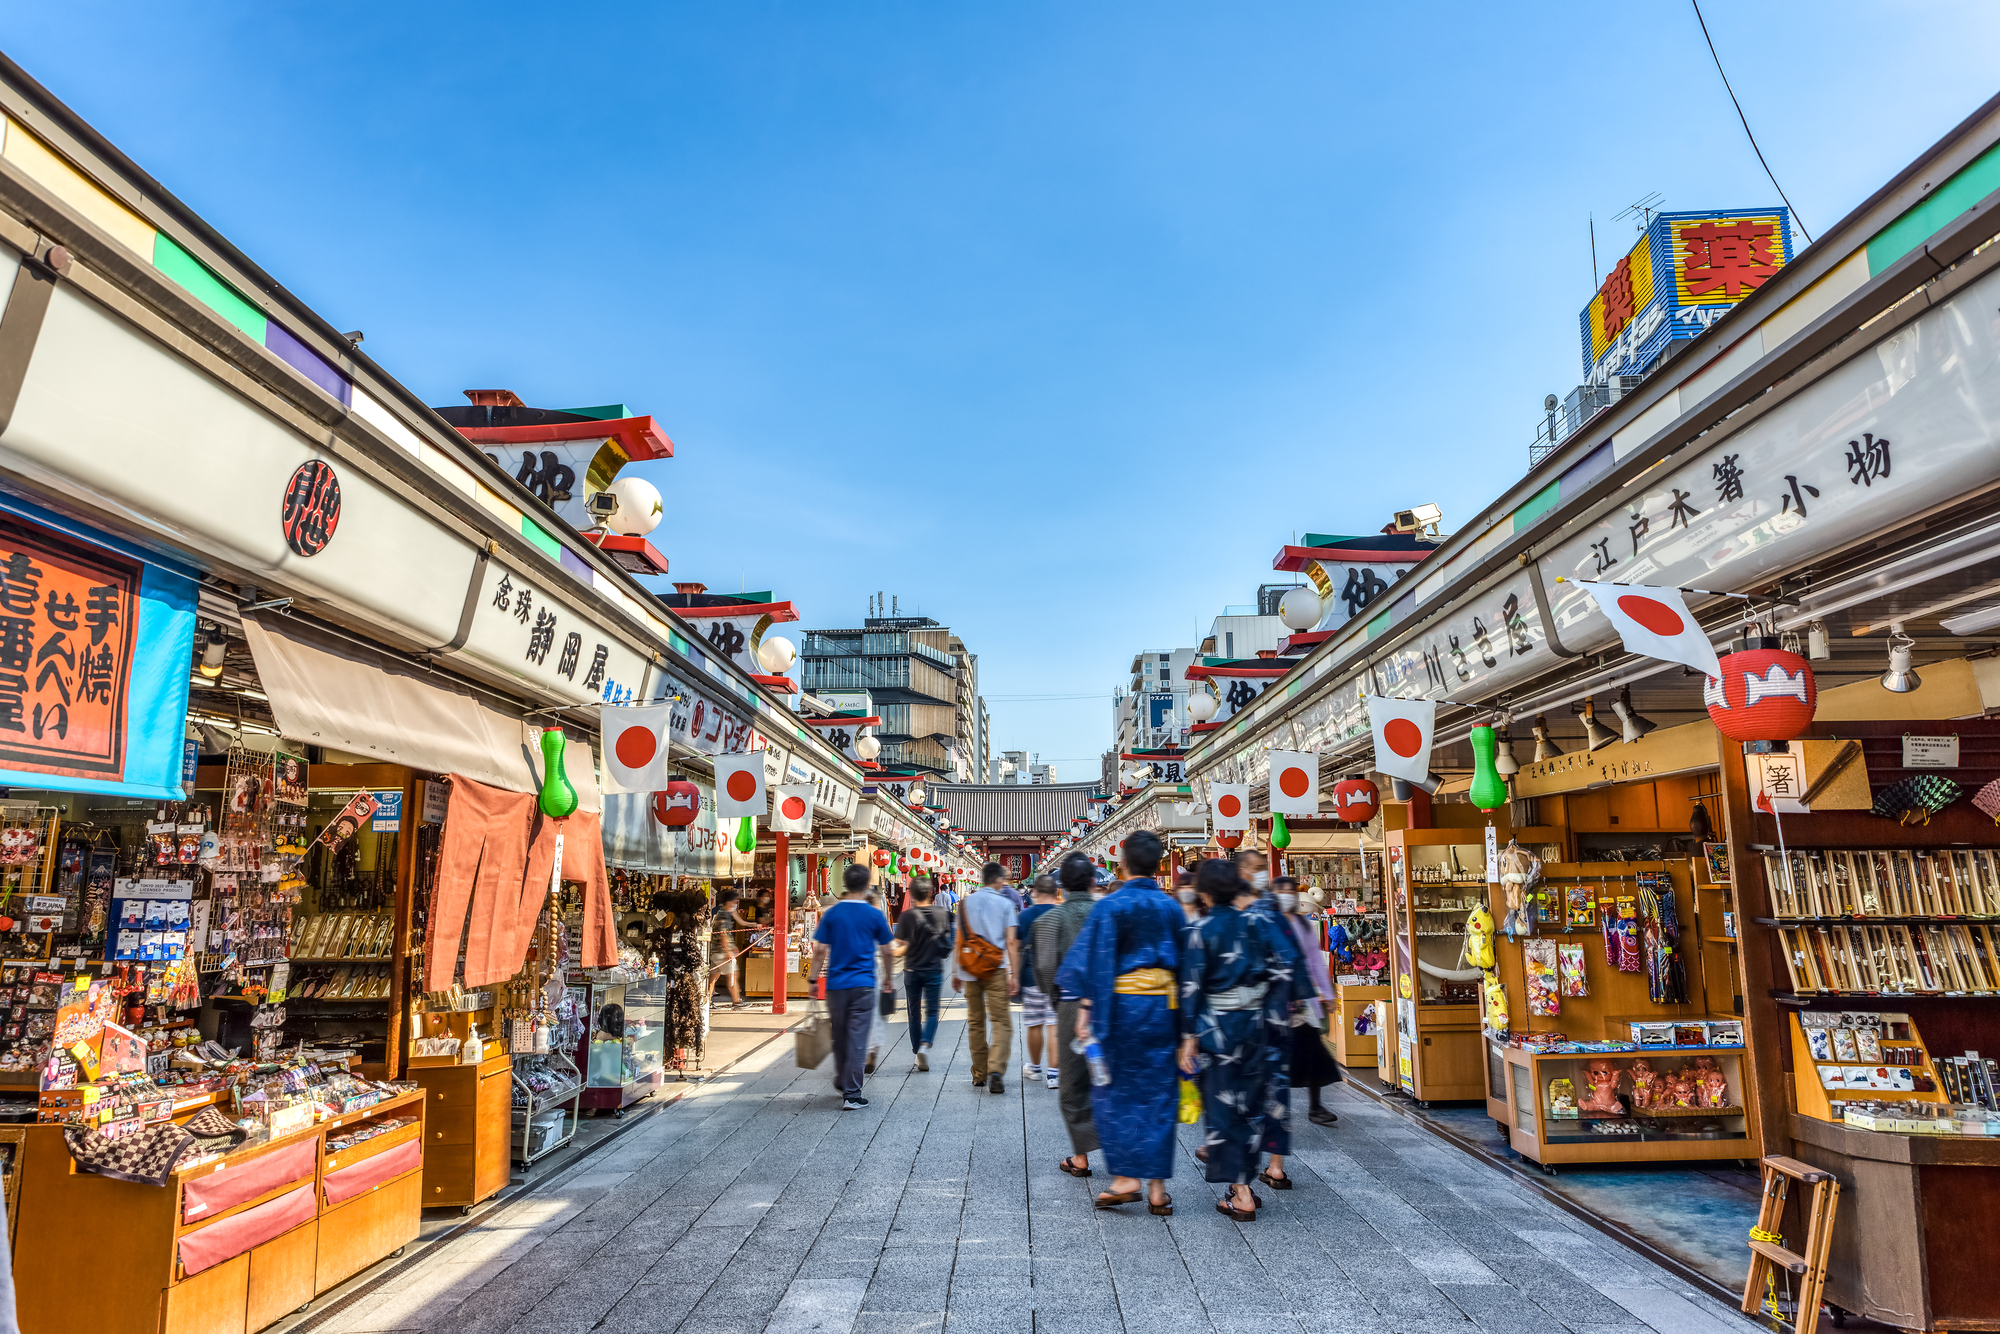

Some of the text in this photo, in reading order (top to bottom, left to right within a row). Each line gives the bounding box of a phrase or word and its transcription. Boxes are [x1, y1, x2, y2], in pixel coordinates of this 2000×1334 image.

[1680, 221, 1779, 297] 薬
[1590, 433, 1892, 576] 江戸木箸 小物
[492, 572, 610, 693] 念珠 静岡屋
